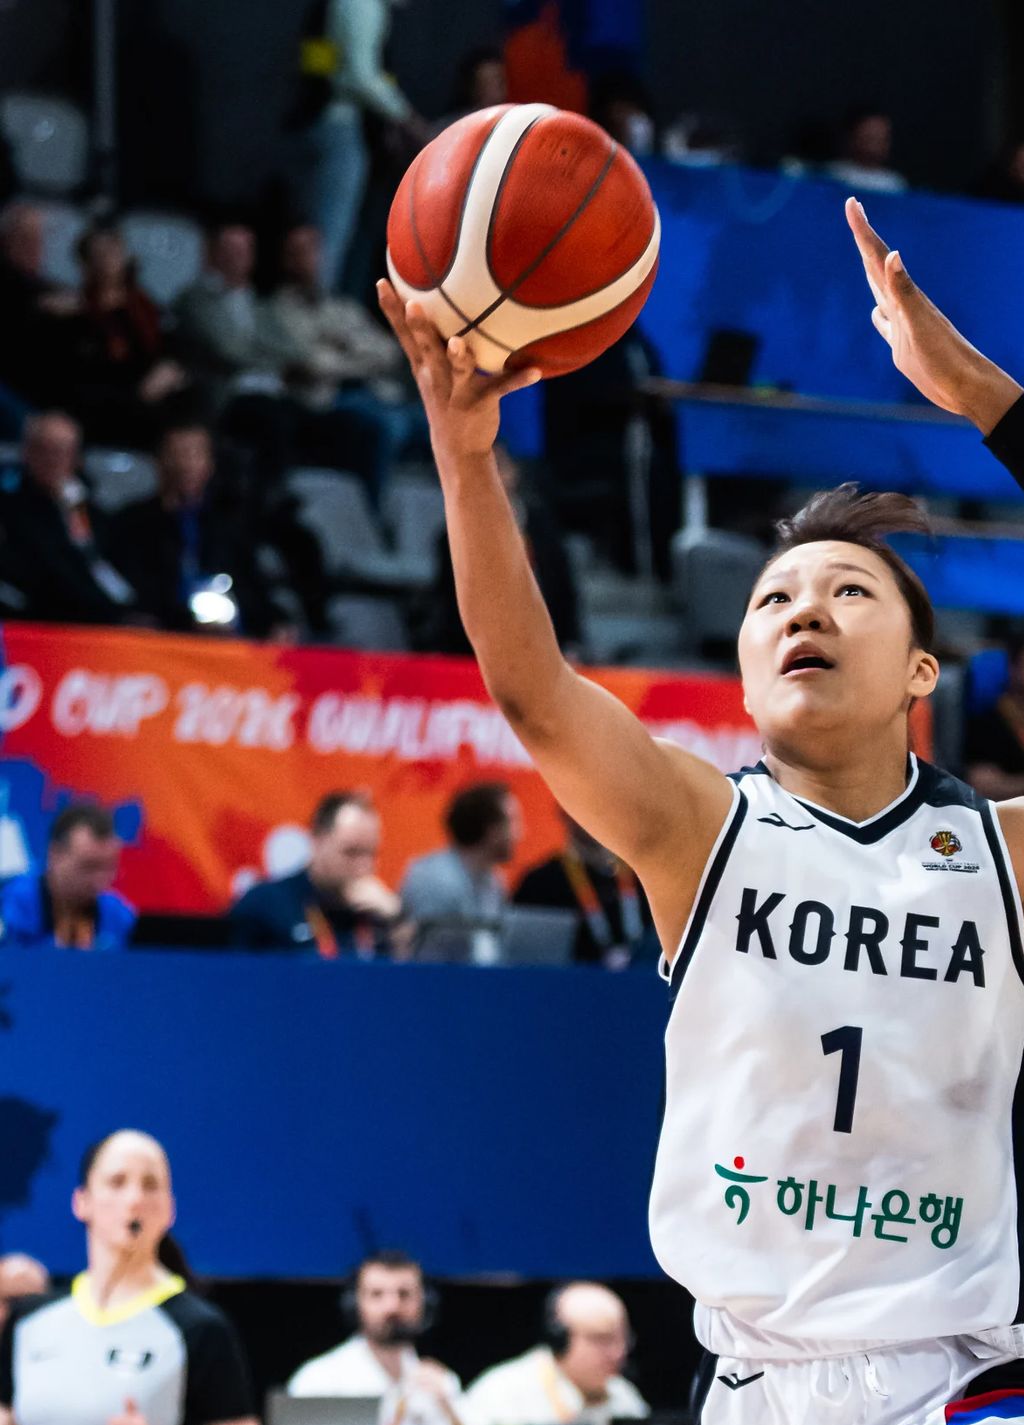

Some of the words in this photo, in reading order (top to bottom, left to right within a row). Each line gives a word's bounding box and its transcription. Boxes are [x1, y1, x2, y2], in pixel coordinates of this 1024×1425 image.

[53, 669, 169, 737] CUP
[735, 887, 986, 988] KOREA
[820, 1025, 863, 1134] 1
[776, 1176, 964, 1250] 하나은행
